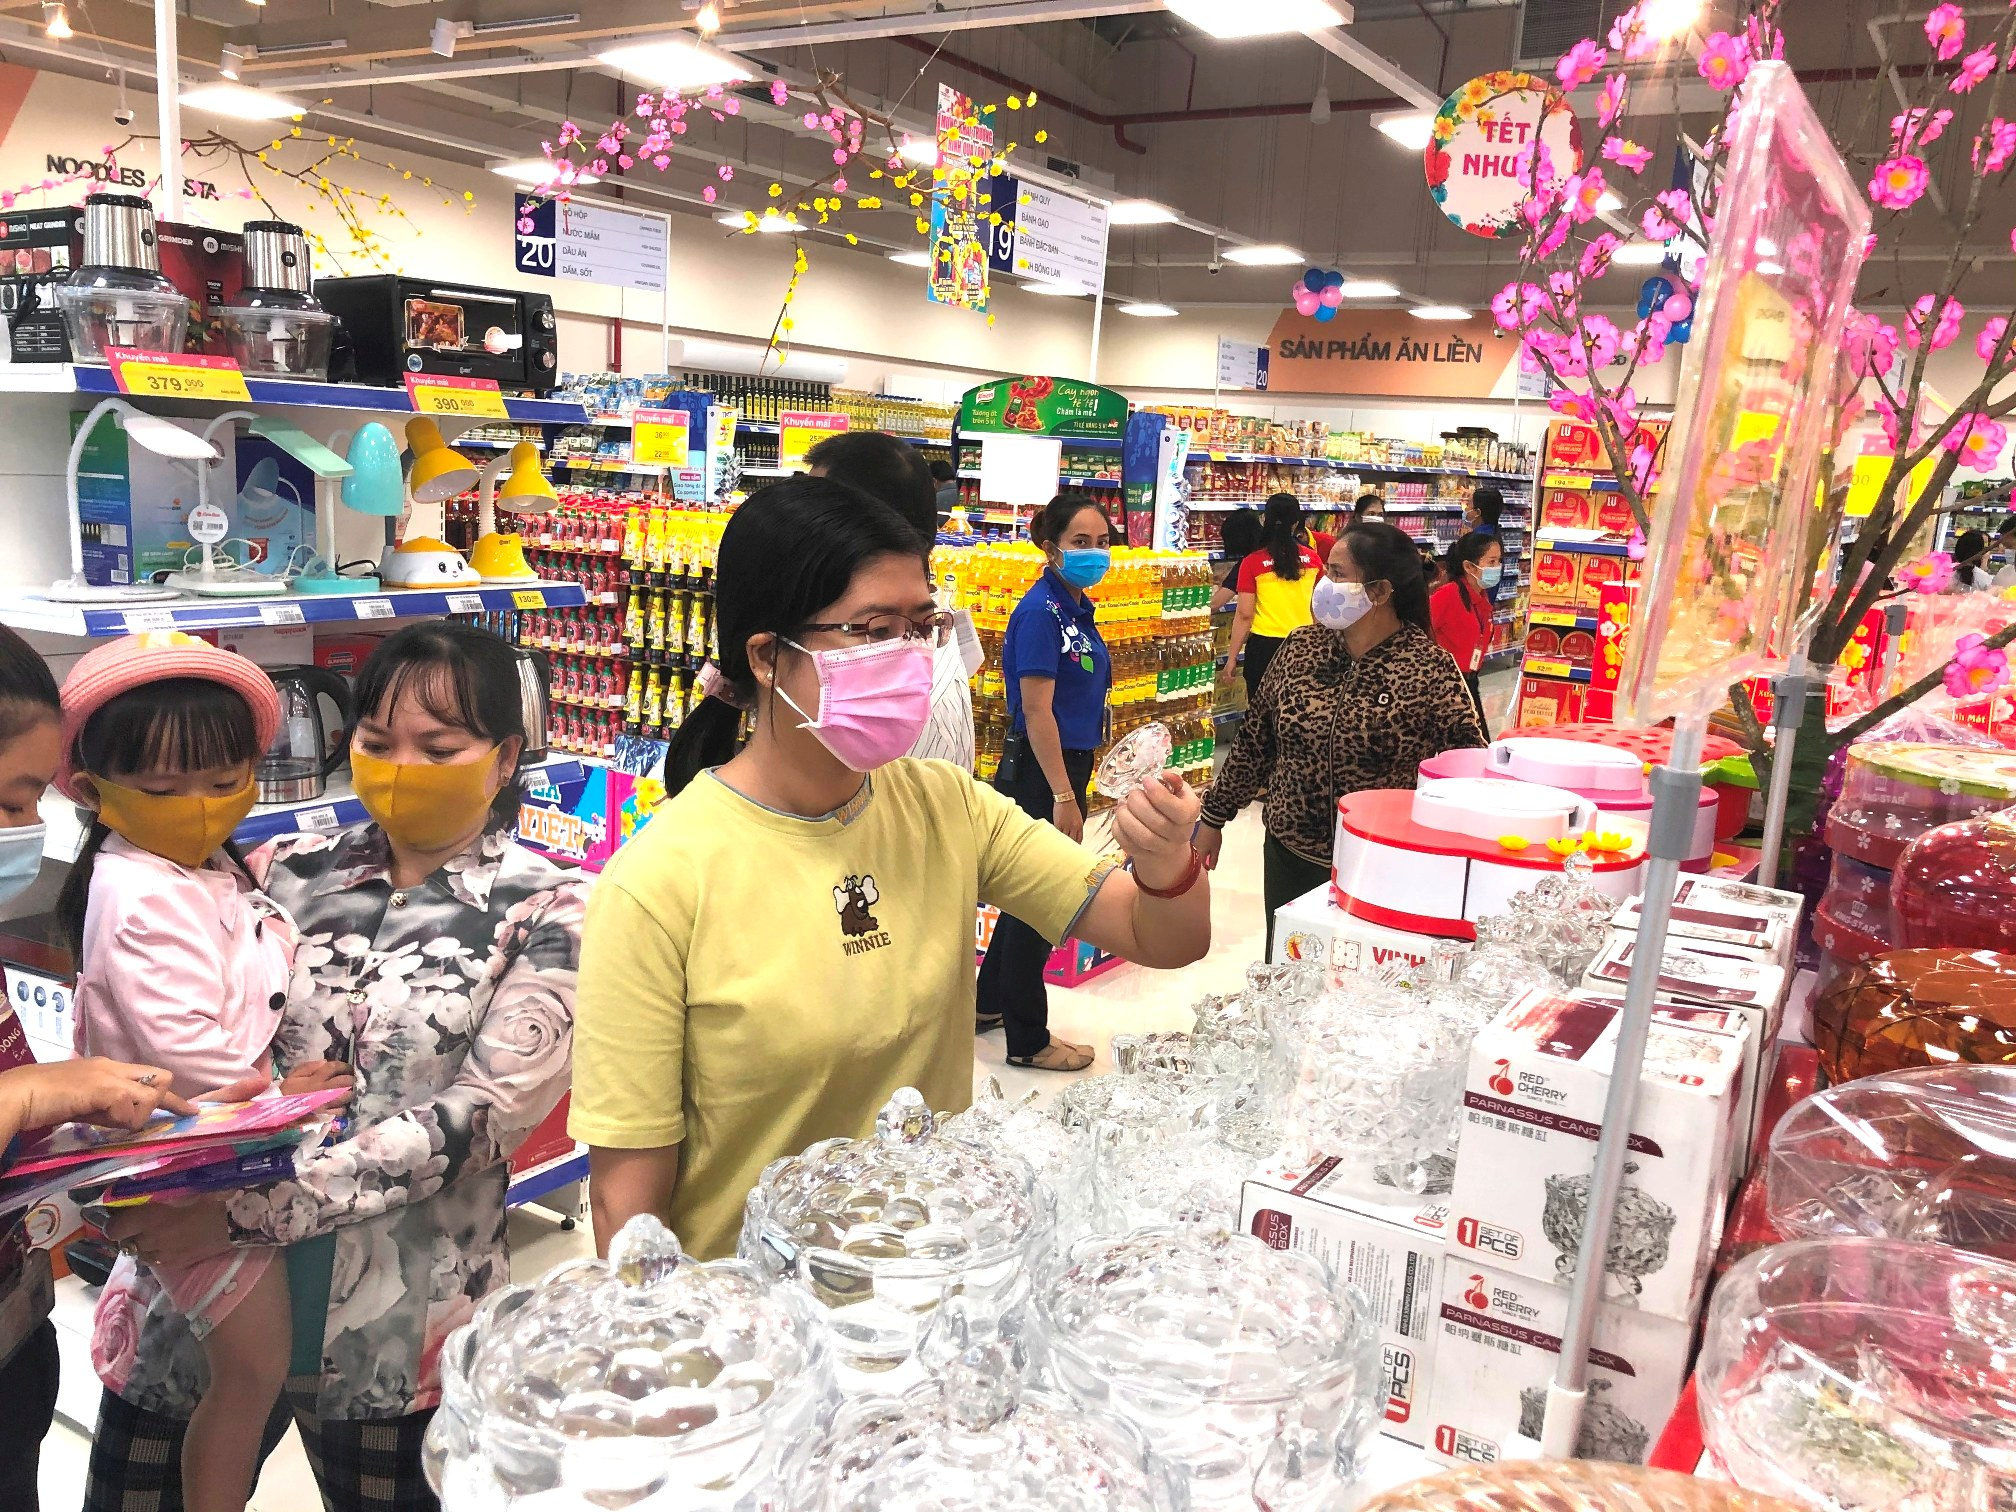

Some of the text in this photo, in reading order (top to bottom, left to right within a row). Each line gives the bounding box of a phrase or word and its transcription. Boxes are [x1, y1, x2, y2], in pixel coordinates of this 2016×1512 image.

[1483, 112, 1531, 145] TẾT
[1021, 211, 1036, 224] BÁNH
[989, 222, 1013, 261] 19
[521, 241, 554, 268] 20
[1279, 332, 1482, 363] SẢN PHẨM ĂN LIỀN
[115, 351, 169, 364] Khuyến mãi
[410, 376, 436, 387] Khuyến
[1257, 369, 1267, 386] 20
[1058, 384, 1077, 400] Cay
[635, 414, 661, 424] Khuyến
[784, 416, 813, 428] Khuyến
[1560, 425, 1571, 437] LU
[1553, 492, 1564, 503] LU
[1607, 496, 1617, 507] LU
[1543, 554, 1552, 564] LU
[1590, 558, 1599, 568] LU
[1526, 681, 1537, 692] LU
[842, 931, 892, 957] WINNIE
[1519, 1071, 1544, 1086] RED
[1517, 1082, 1568, 1101] CHERRY
[1469, 1096, 1554, 1126] PARNASSUS
[1558, 1119, 1601, 1138] CAND
[1278, 1223, 1289, 1249] BOX
[1480, 1226, 1503, 1239] SET
[1504, 1233, 1520, 1243] OF
[1478, 1234, 1519, 1257] PCS
[1493, 1287, 1518, 1302] RED
[1492, 1297, 1541, 1318] CHERRY
[1446, 1308, 1528, 1340] PARNASSUS
[1391, 1351, 1411, 1399] PCS
[1457, 1433, 1480, 1447] SET
[1480, 1443, 1496, 1453] OF
[1455, 1442, 1495, 1464] PCS
